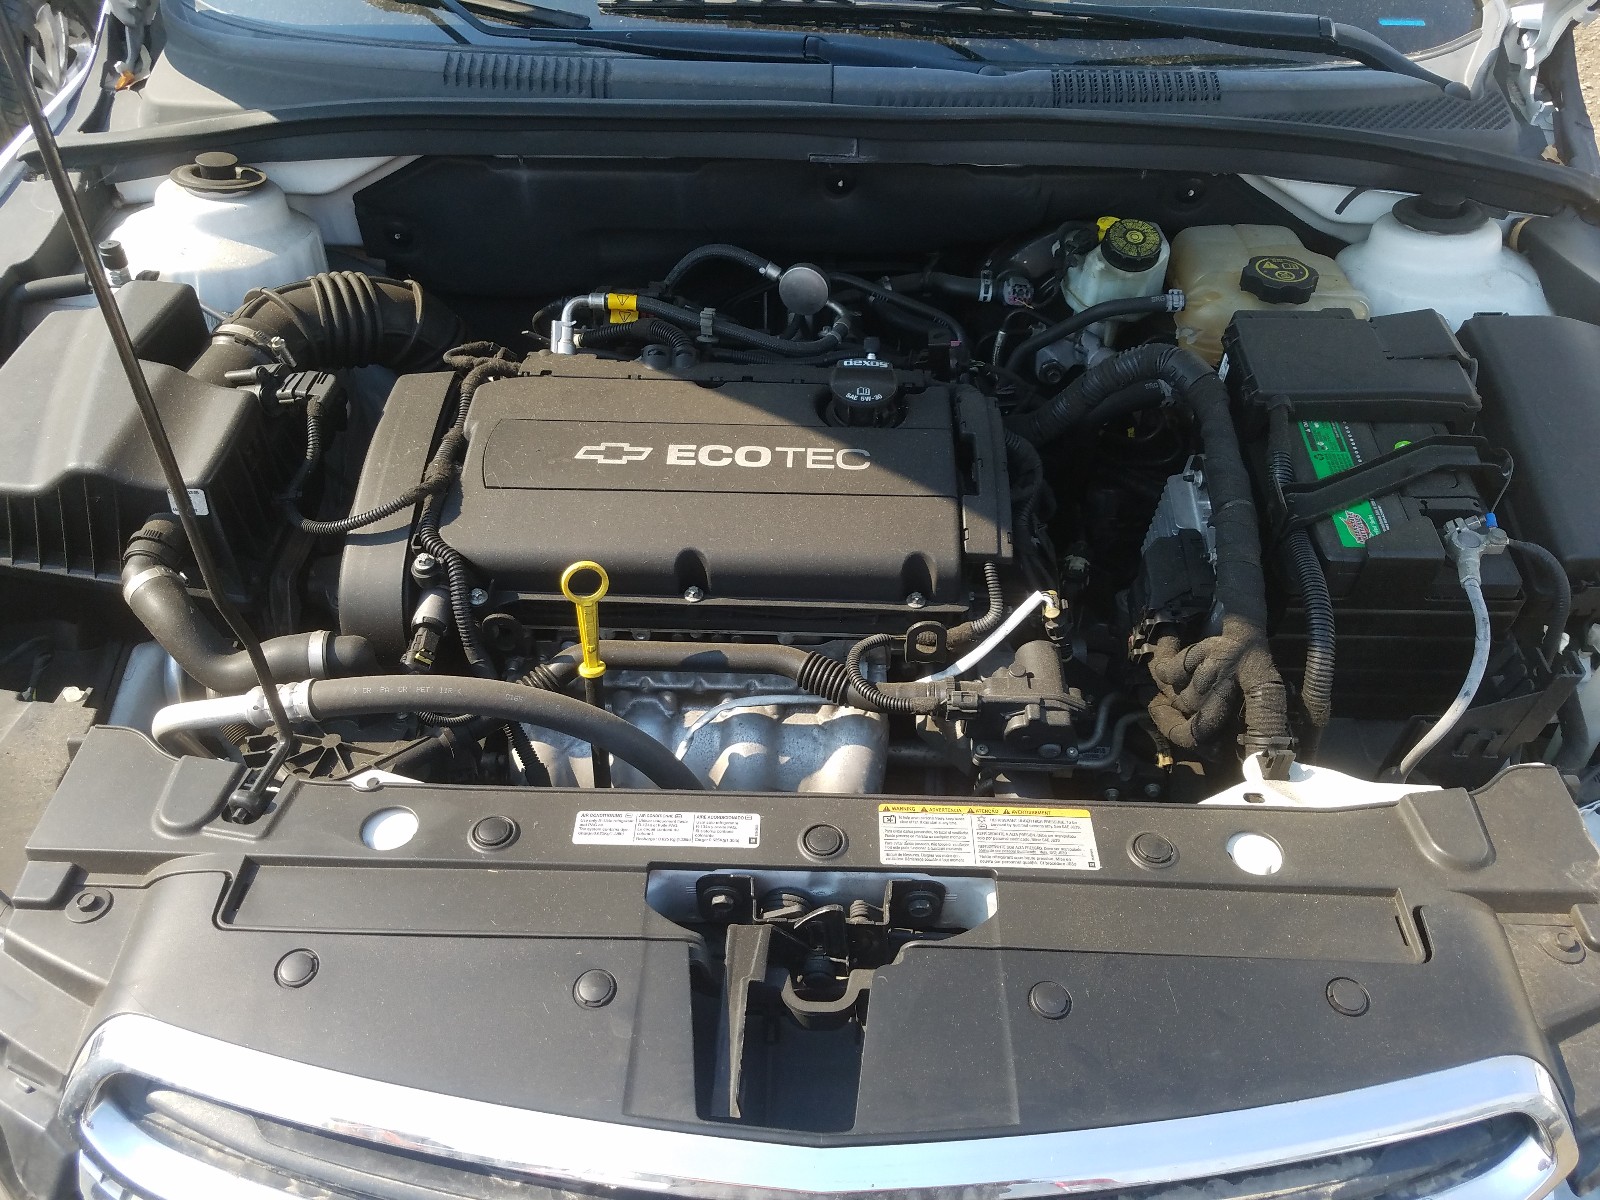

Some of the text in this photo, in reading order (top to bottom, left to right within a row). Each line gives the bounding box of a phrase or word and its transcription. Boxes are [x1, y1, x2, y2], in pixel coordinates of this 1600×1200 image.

[843, 358, 888, 368] dexos
[845, 392, 883, 402] SAE 5W-30
[666, 444, 871, 470] ECOTEC
